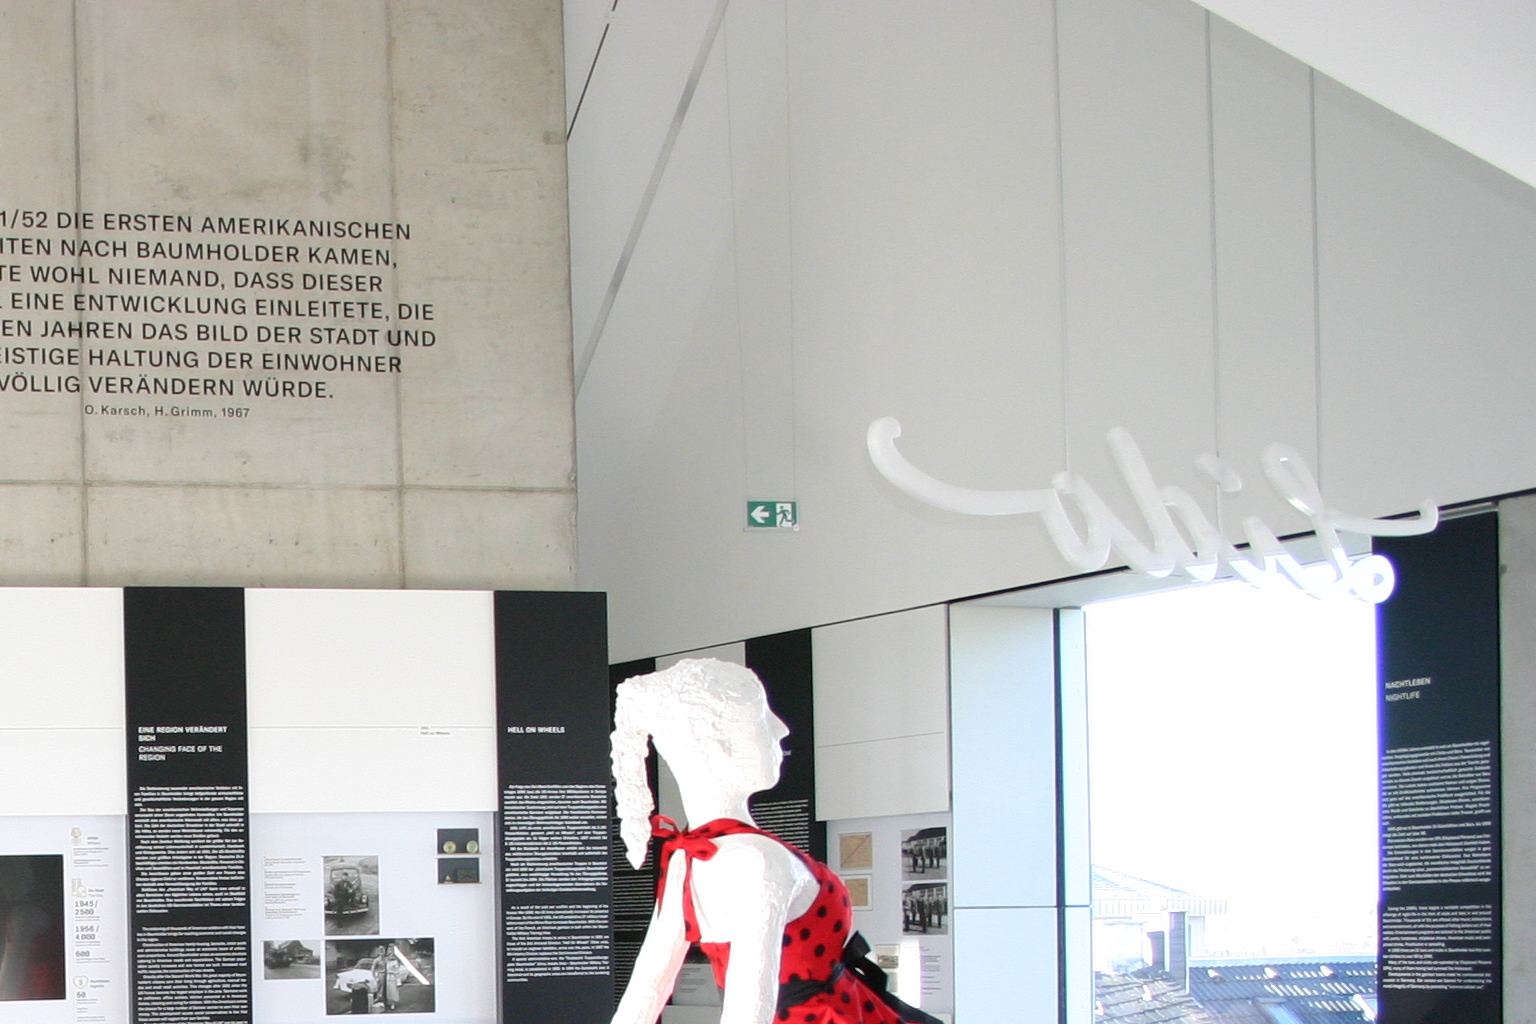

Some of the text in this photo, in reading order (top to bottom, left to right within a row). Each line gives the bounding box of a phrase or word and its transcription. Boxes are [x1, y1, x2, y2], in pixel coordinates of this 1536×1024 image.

[57, 211, 95, 231] DIE
[103, 213, 192, 233] ERSTEN
[200, 216, 411, 241] AMERIKANISCHEN
[61, 239, 127, 258] NACH
[136, 241, 300, 263] BAUMHOLDER
[308, 246, 397, 270] KAMEN,
[29, 265, 101, 285] WOHL
[108, 267, 226, 291] NIEMAND,
[234, 271, 294, 290] DASS
[302, 273, 383, 293] DIESER
[11, 292, 65, 311] EINE
[73, 293, 247, 316] ENTWICKLUNG
[255, 298, 390, 322] EINLEITETE,
[397, 303, 435, 321] DIE
[40, 320, 133, 340] JAHREN
[142, 322, 188, 341] DAS
[196, 324, 249, 342] BILD
[256, 325, 302, 344] DER
[309, 327, 380, 346] STADT
[386, 329, 437, 347] UND
[88, 348, 199, 369] HALTUNG
[207, 351, 253, 370] DER
[262, 352, 402, 374] EINWOHNER
[88, 376, 234, 396] VERÄNDERN
[242, 377, 334, 399] WÜRDE.
[84, 404, 250, 419] O. Karsch, H. Grimm, 1967
[1385, 677, 1431, 689] NACHTLEBEN
[138, 726, 155, 734] EINE
[177, 745, 195, 753] FACE
[197, 745, 207, 753] OF
[209, 745, 223, 753] THE
